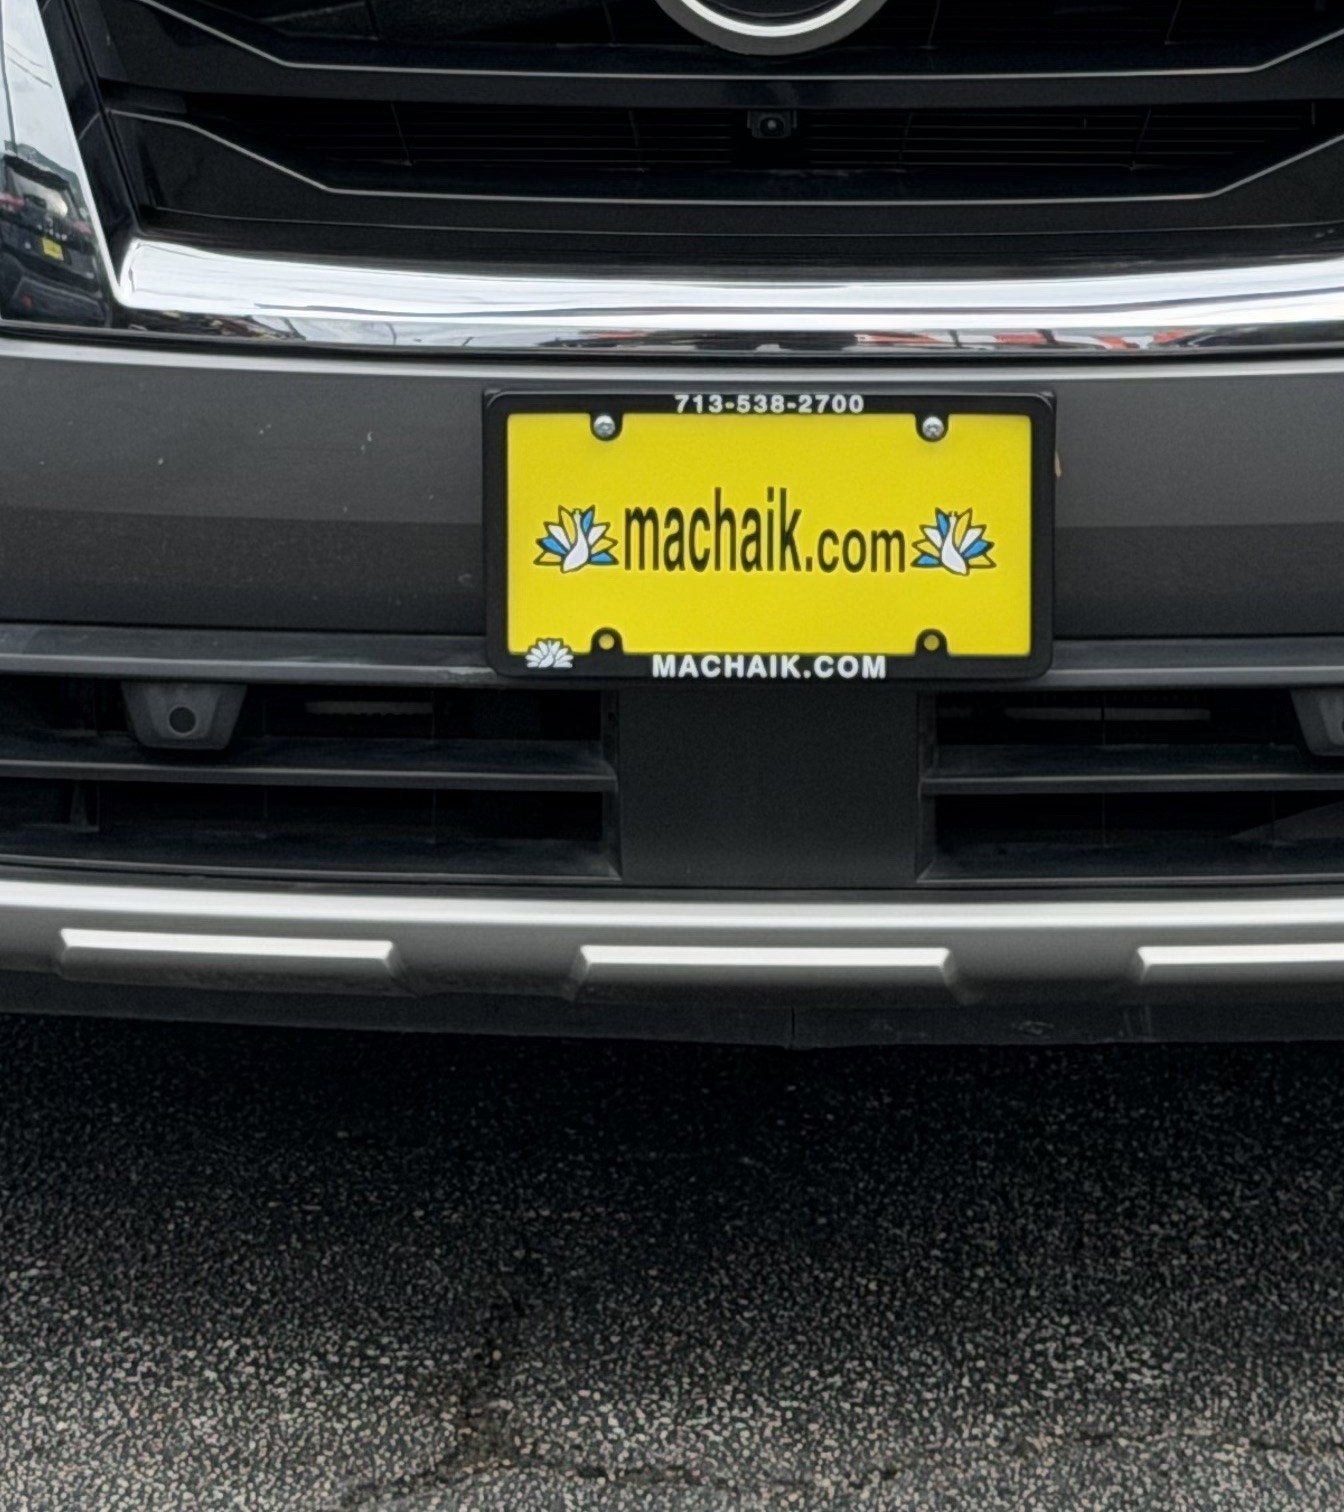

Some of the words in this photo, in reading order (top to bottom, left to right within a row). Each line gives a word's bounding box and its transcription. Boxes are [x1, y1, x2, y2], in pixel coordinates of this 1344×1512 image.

[675, 394, 864, 413] 713-538-2700
[624, 486, 906, 573] machaik.com
[652, 655, 887, 679] MACHAIK.COM
